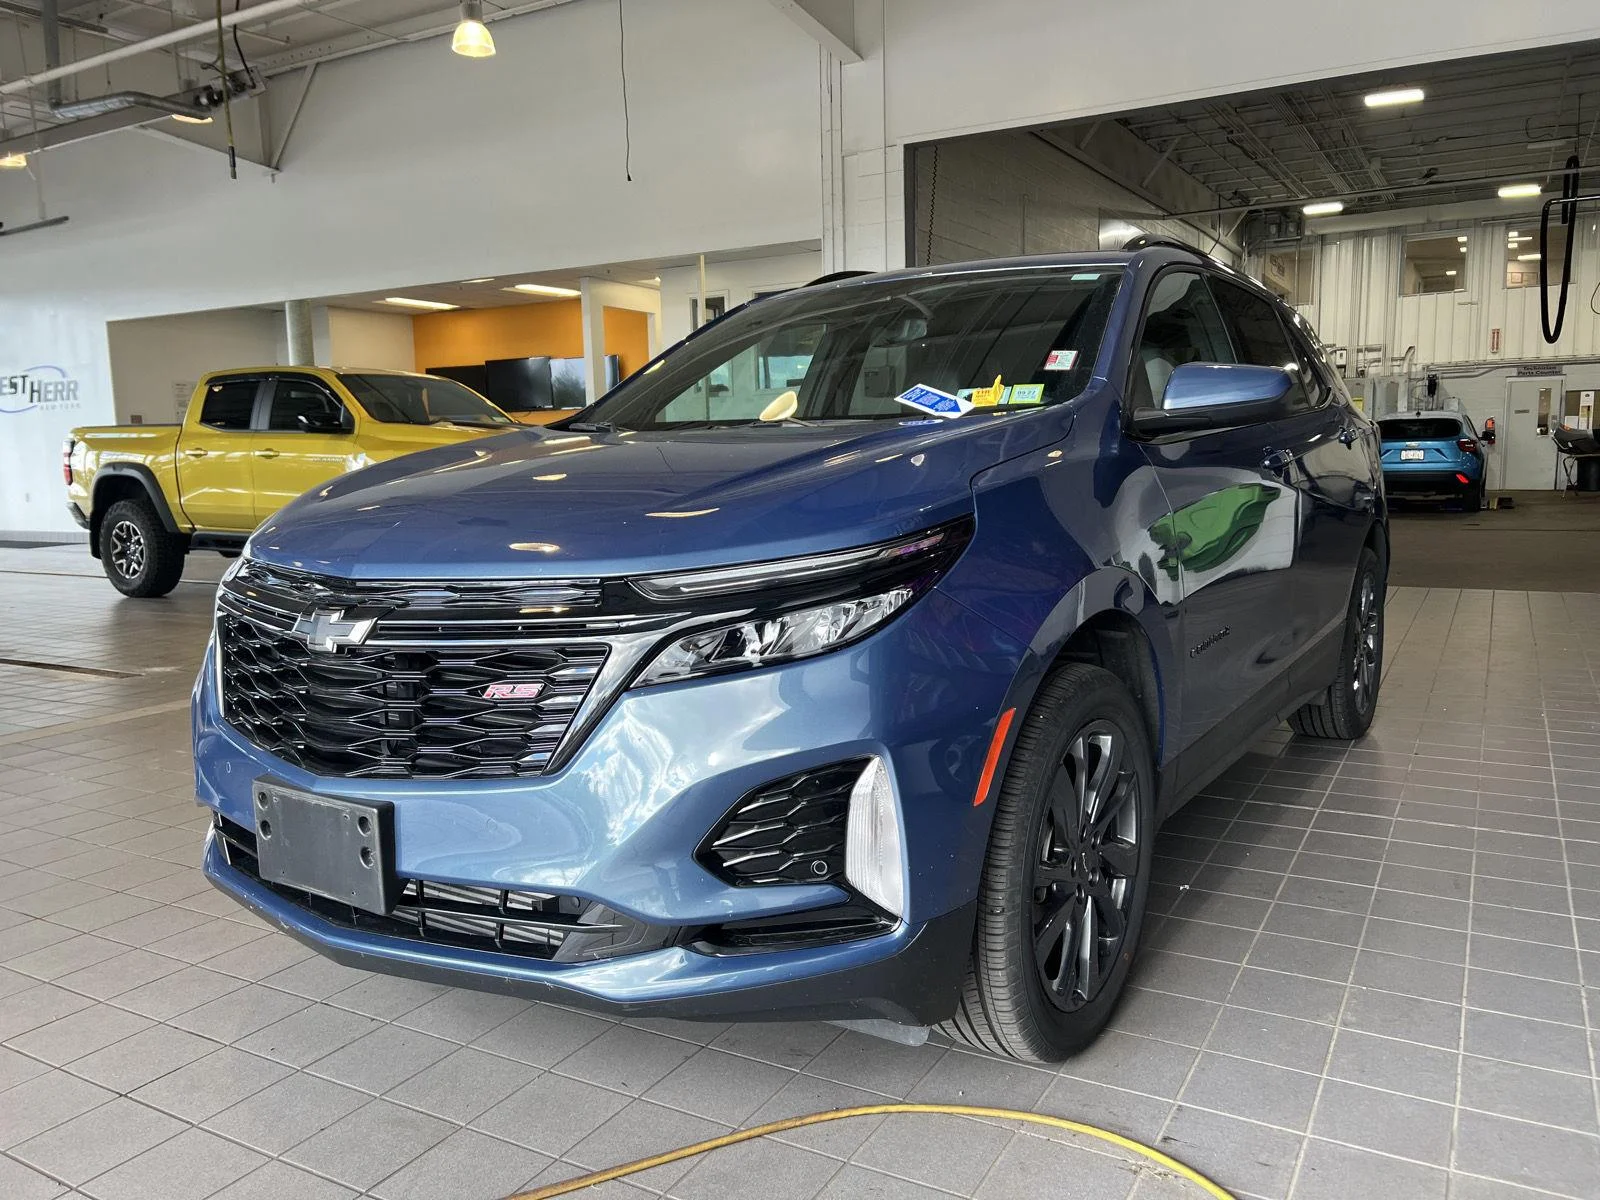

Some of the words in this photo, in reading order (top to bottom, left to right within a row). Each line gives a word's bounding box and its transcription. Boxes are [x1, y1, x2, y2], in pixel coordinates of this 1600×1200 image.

[0, 375, 28, 396] EST
[30, 380, 78, 403] HERR
[482, 683, 545, 699] RS
